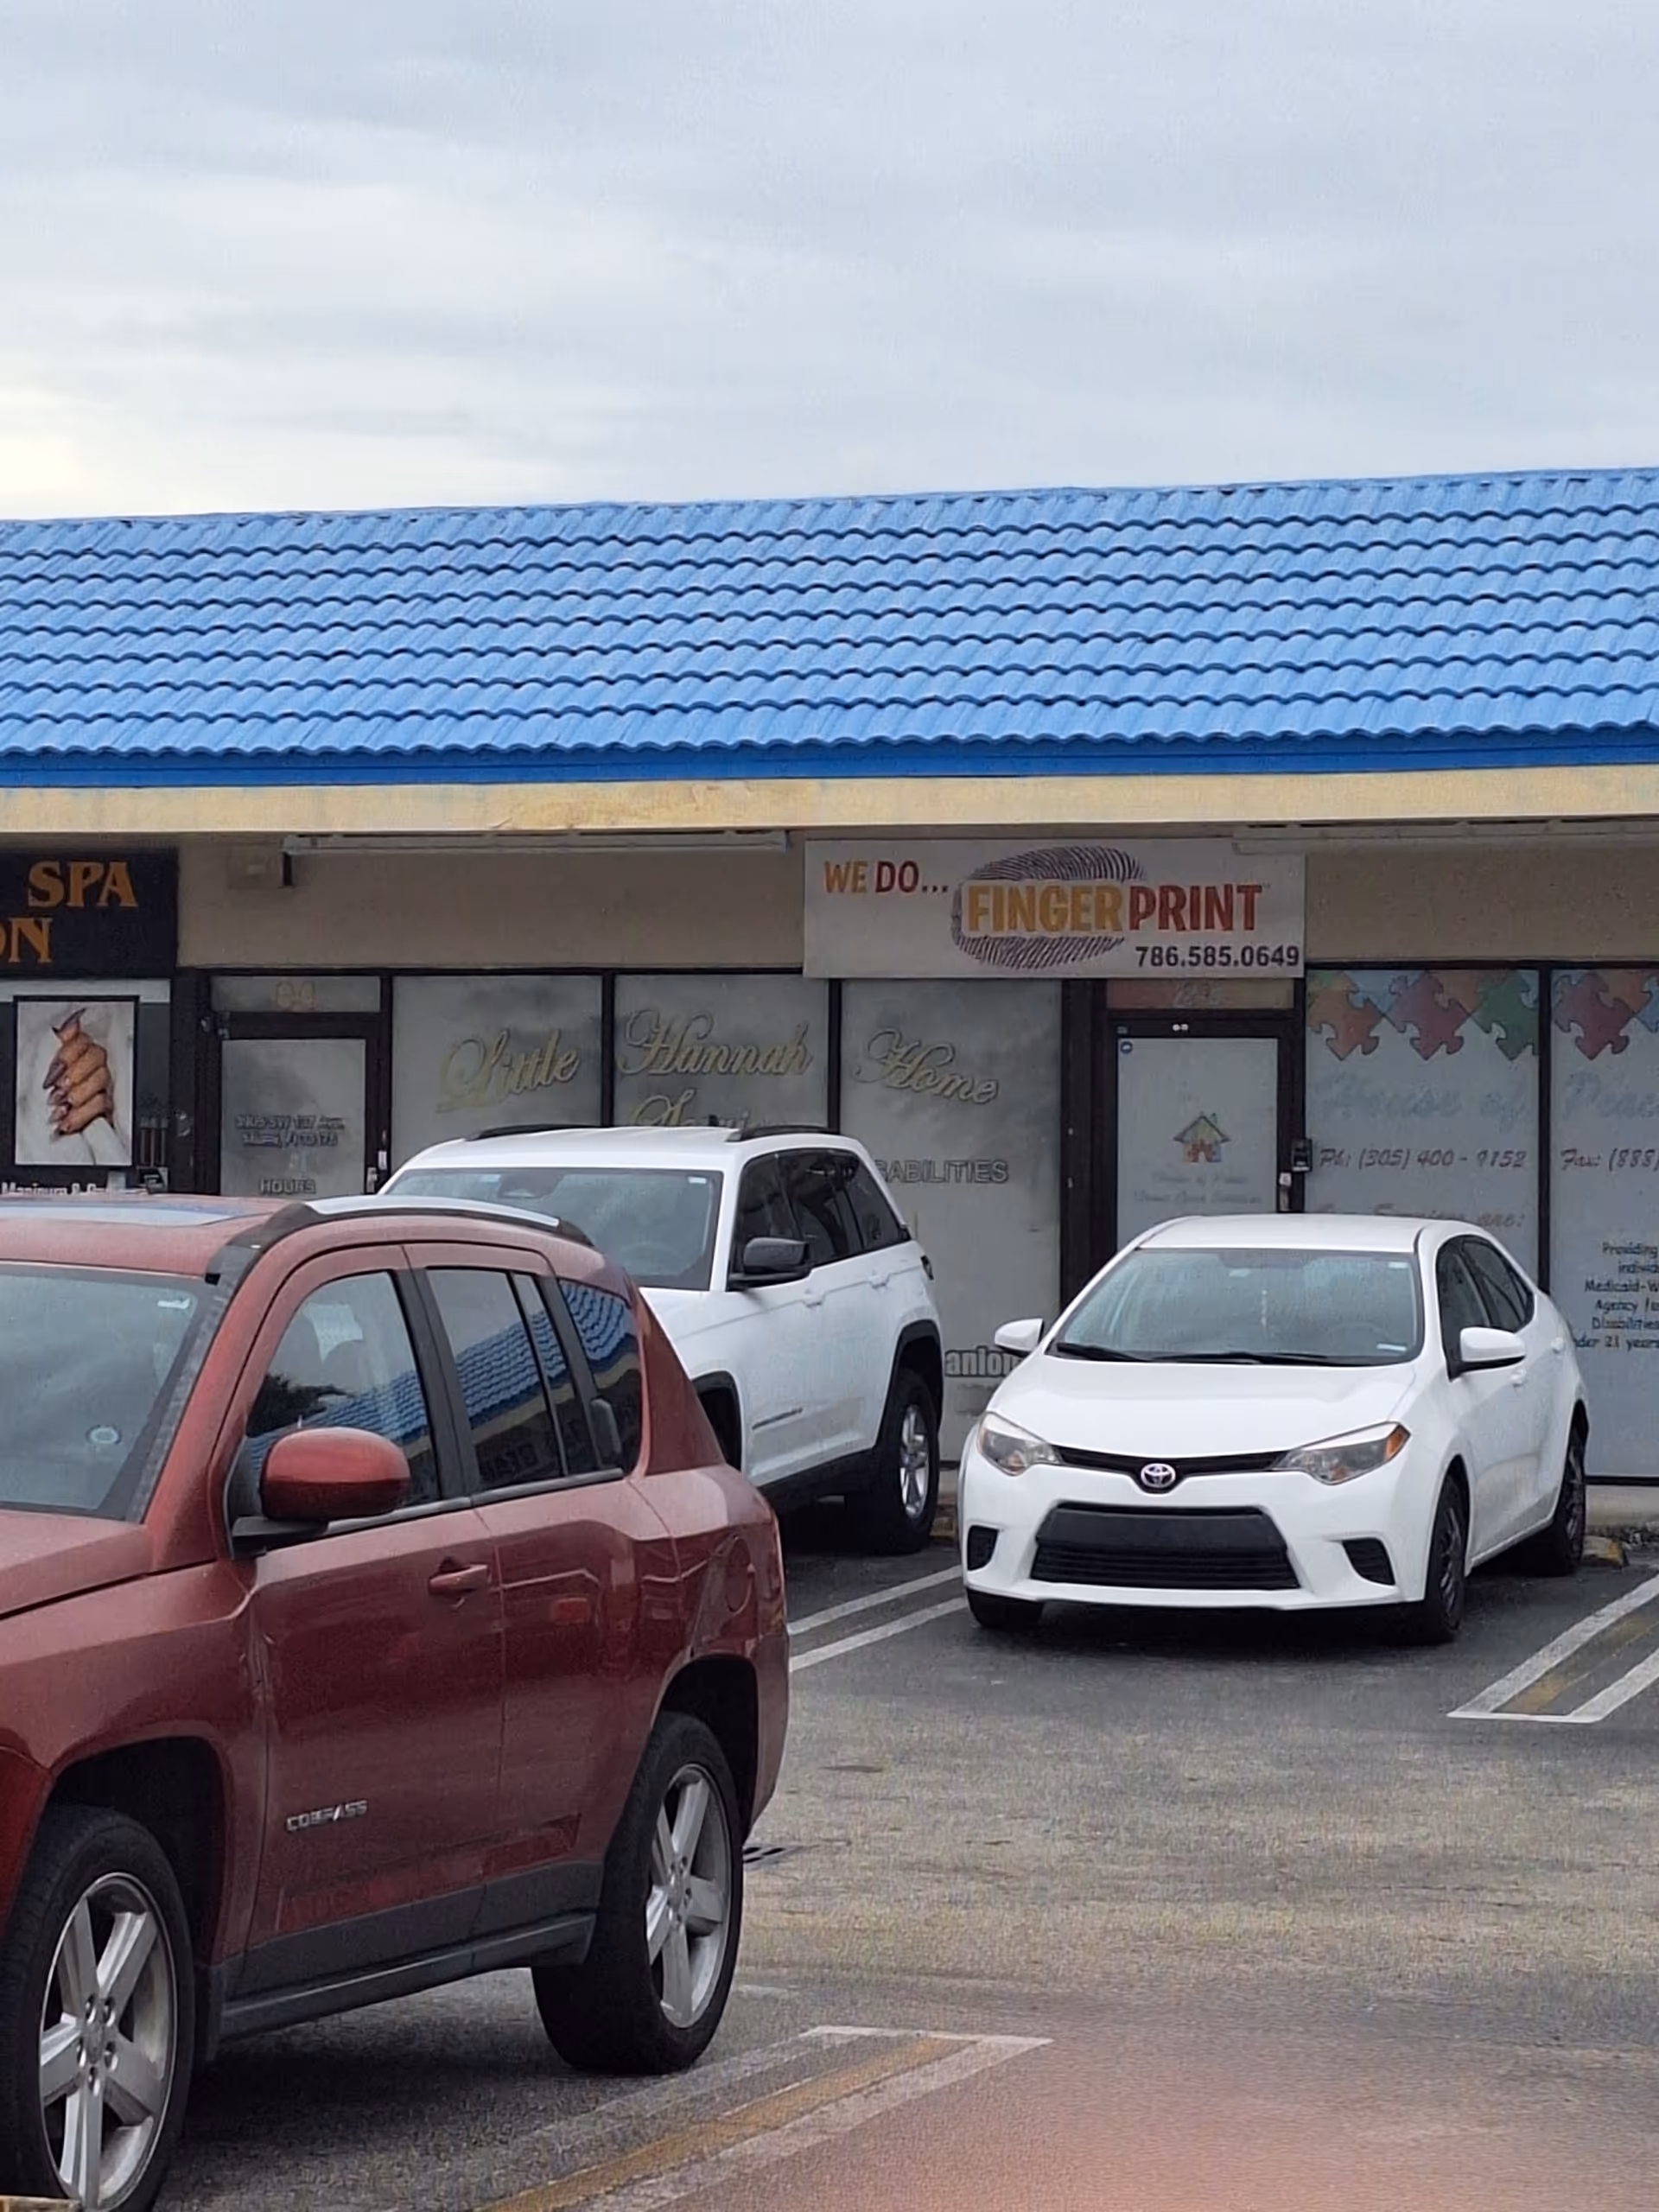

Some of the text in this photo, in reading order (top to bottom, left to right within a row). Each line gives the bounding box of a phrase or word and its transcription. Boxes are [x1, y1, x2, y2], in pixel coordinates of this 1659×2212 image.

[28, 860, 138, 908] SPA
[823, 861, 868, 893] WE
[1135, 945, 1300, 968] 786.585.0649
[436, 1028, 581, 1113] Little
[617, 1008, 812, 1077] Hannah
[855, 1028, 1000, 1105] Home
[1358, 1147, 1411, 1171] (305)
